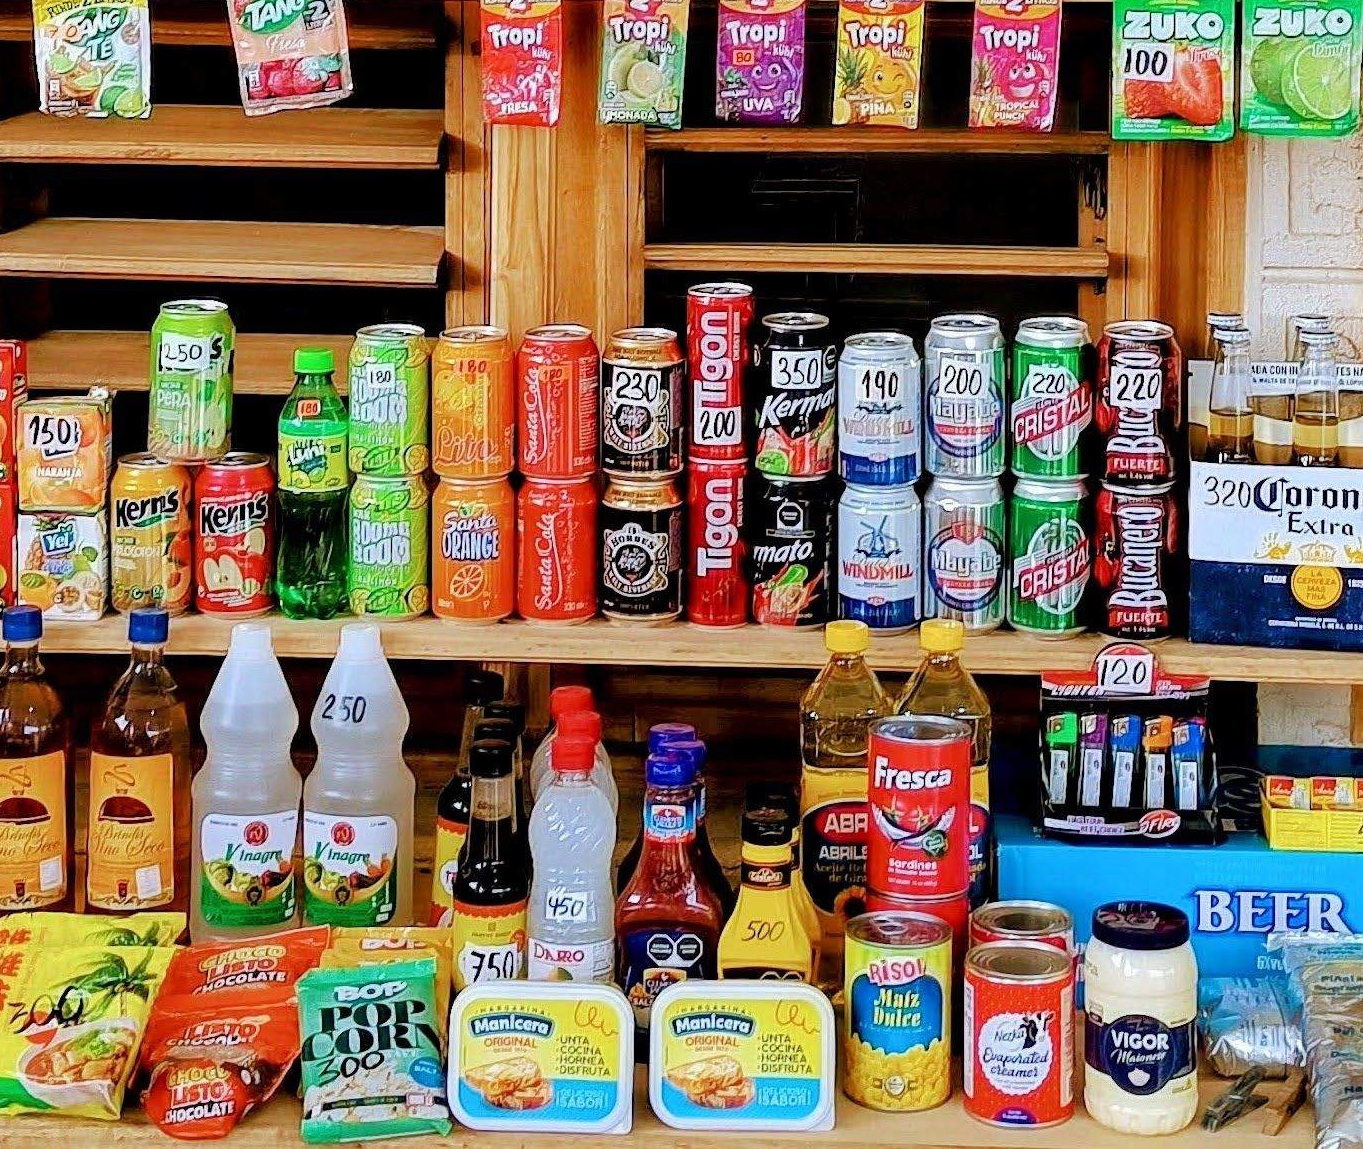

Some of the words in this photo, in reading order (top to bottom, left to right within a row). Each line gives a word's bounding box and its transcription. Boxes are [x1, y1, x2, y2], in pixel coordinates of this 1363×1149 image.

[1122, 10, 1225, 41] ZUKO
[1252, 6, 1353, 37] ZUKO
[725, 20, 786, 48] Tropi
[1124, 48, 1168, 77] 100
[500, 101, 538, 114] FRESA
[743, 98, 773, 113] UVA
[860, 98, 894, 115] PIÑA
[164, 343, 203, 363] 250
[369, 369, 391, 383] 180
[459, 360, 486, 373] 180
[778, 358, 819, 383] 350
[1269, 365, 1288, 375] CON
[615, 371, 659, 401] 230
[860, 371, 898, 399] 190
[944, 364, 983, 395] 200
[1033, 374, 1065, 393] 220
[1116, 374, 1159, 400] 220
[299, 403, 319, 415] 180
[700, 410, 736, 439] 200
[35, 466, 83, 478] NARANJA
[1112, 457, 1160, 470] FUERTE
[1204, 476, 1252, 508] 320
[443, 512, 497, 533] Santa
[698, 477, 738, 577] Tigon
[1288, 512, 1354, 536] Extra
[442, 532, 500, 560] ORANGE
[843, 561, 914, 579] WINDMILL
[1116, 610, 1162, 623] FUERTE
[1101, 659, 1146, 685] 120
[322, 694, 367, 724] 250
[873, 758, 952, 792] Fresca
[224, 841, 283, 863] Vinagre
[314, 841, 370, 863] Vinagre
[888, 858, 937, 871] Sardines
[548, 895, 584, 917] 450
[1196, 890, 1349, 934] BEER
[741, 920, 785, 942] 500
[334, 980, 407, 1002] BOP
[318, 1000, 427, 1032] POP
[474, 1015, 549, 1035] Manicera
[675, 1014, 751, 1034] Manicera
[484, 1037, 537, 1048] ORIGINAL
[560, 1036, 589, 1046] UNTA
[560, 1046, 602, 1055] COCINA
[685, 1036, 739, 1048] ORIGINAL
[762, 1036, 791, 1046] UNTA
[762, 1046, 803, 1055] COCINA
[1111, 1031, 1169, 1051] VIGOR
[560, 1055, 605, 1065] HORNEA
[761, 1055, 807, 1065] HORNEA
[983, 1048, 1048, 1070] Evaporated
[560, 1065, 611, 1076] DISFRUTA
[761, 1065, 813, 1075] DISFRUTA
[991, 1066, 1038, 1078] creamer
[165, 1103, 234, 1122] CHOCOLATE
